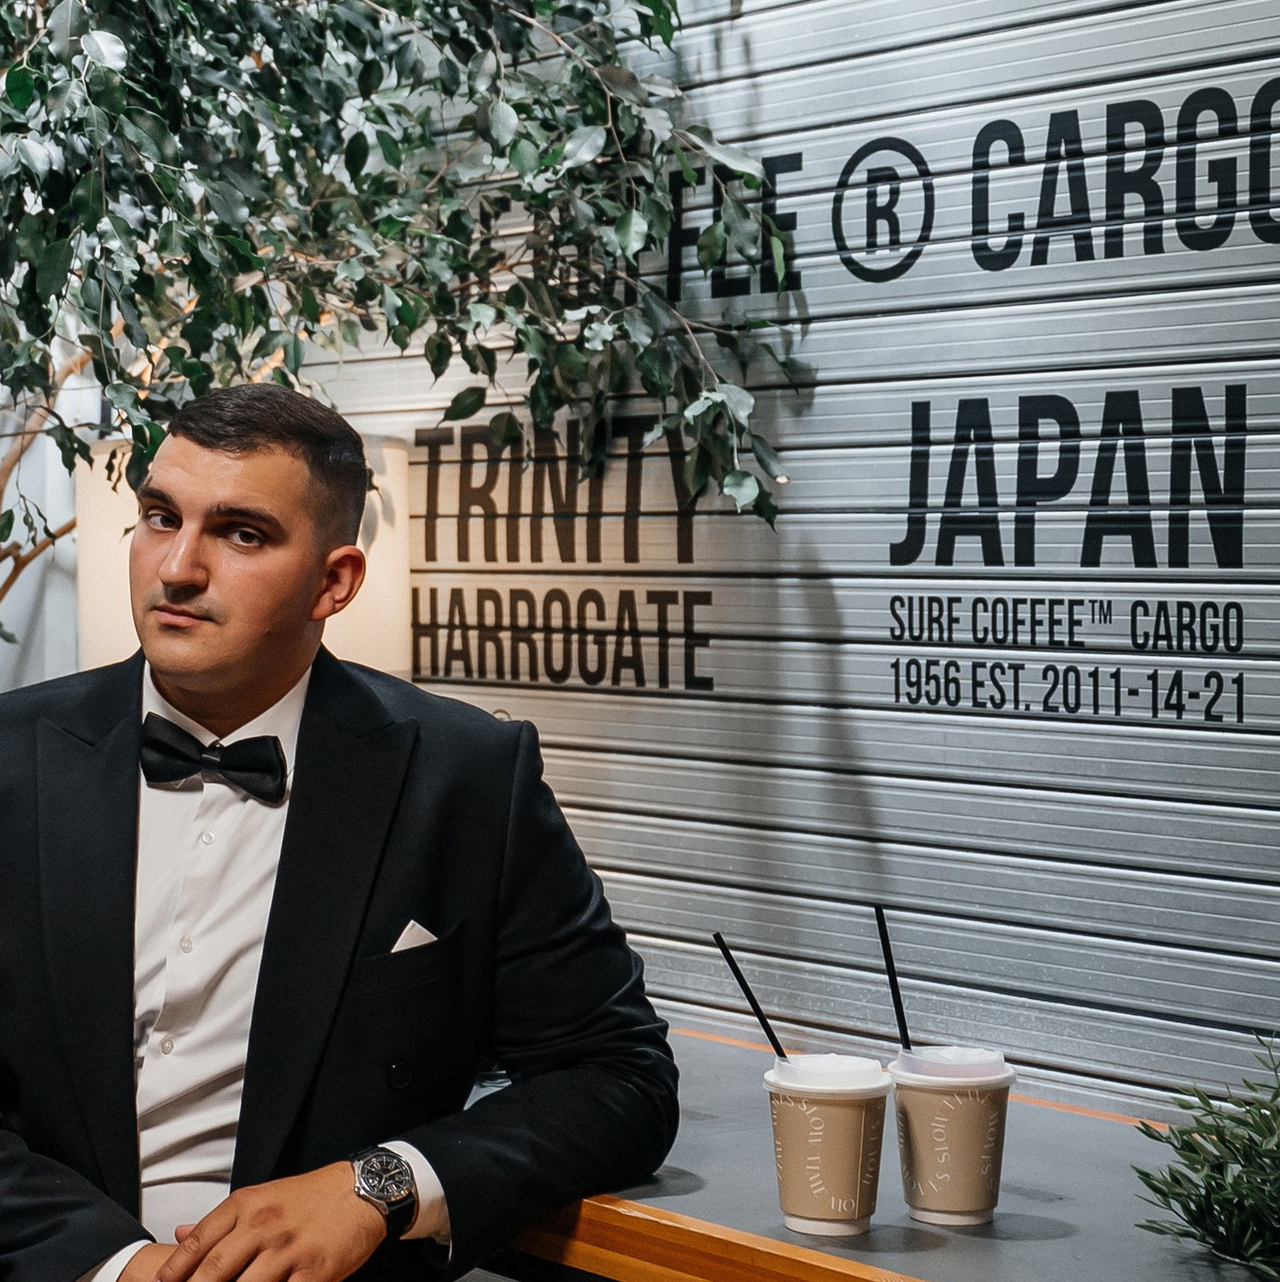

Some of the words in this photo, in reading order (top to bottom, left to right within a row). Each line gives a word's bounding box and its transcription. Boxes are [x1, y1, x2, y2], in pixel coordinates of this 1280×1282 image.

[971, 77, 1280, 272] CARGO
[889, 384, 1248, 569] JAPAN
[412, 587, 714, 691] HARROGATE
[889, 595, 961, 643] SURF
[1130, 600, 1245, 654] CARGO
[890, 657, 961, 707] 1956
[972, 661, 1032, 712] EST.
[1043, 663, 1246, 724] 2011-14-21
